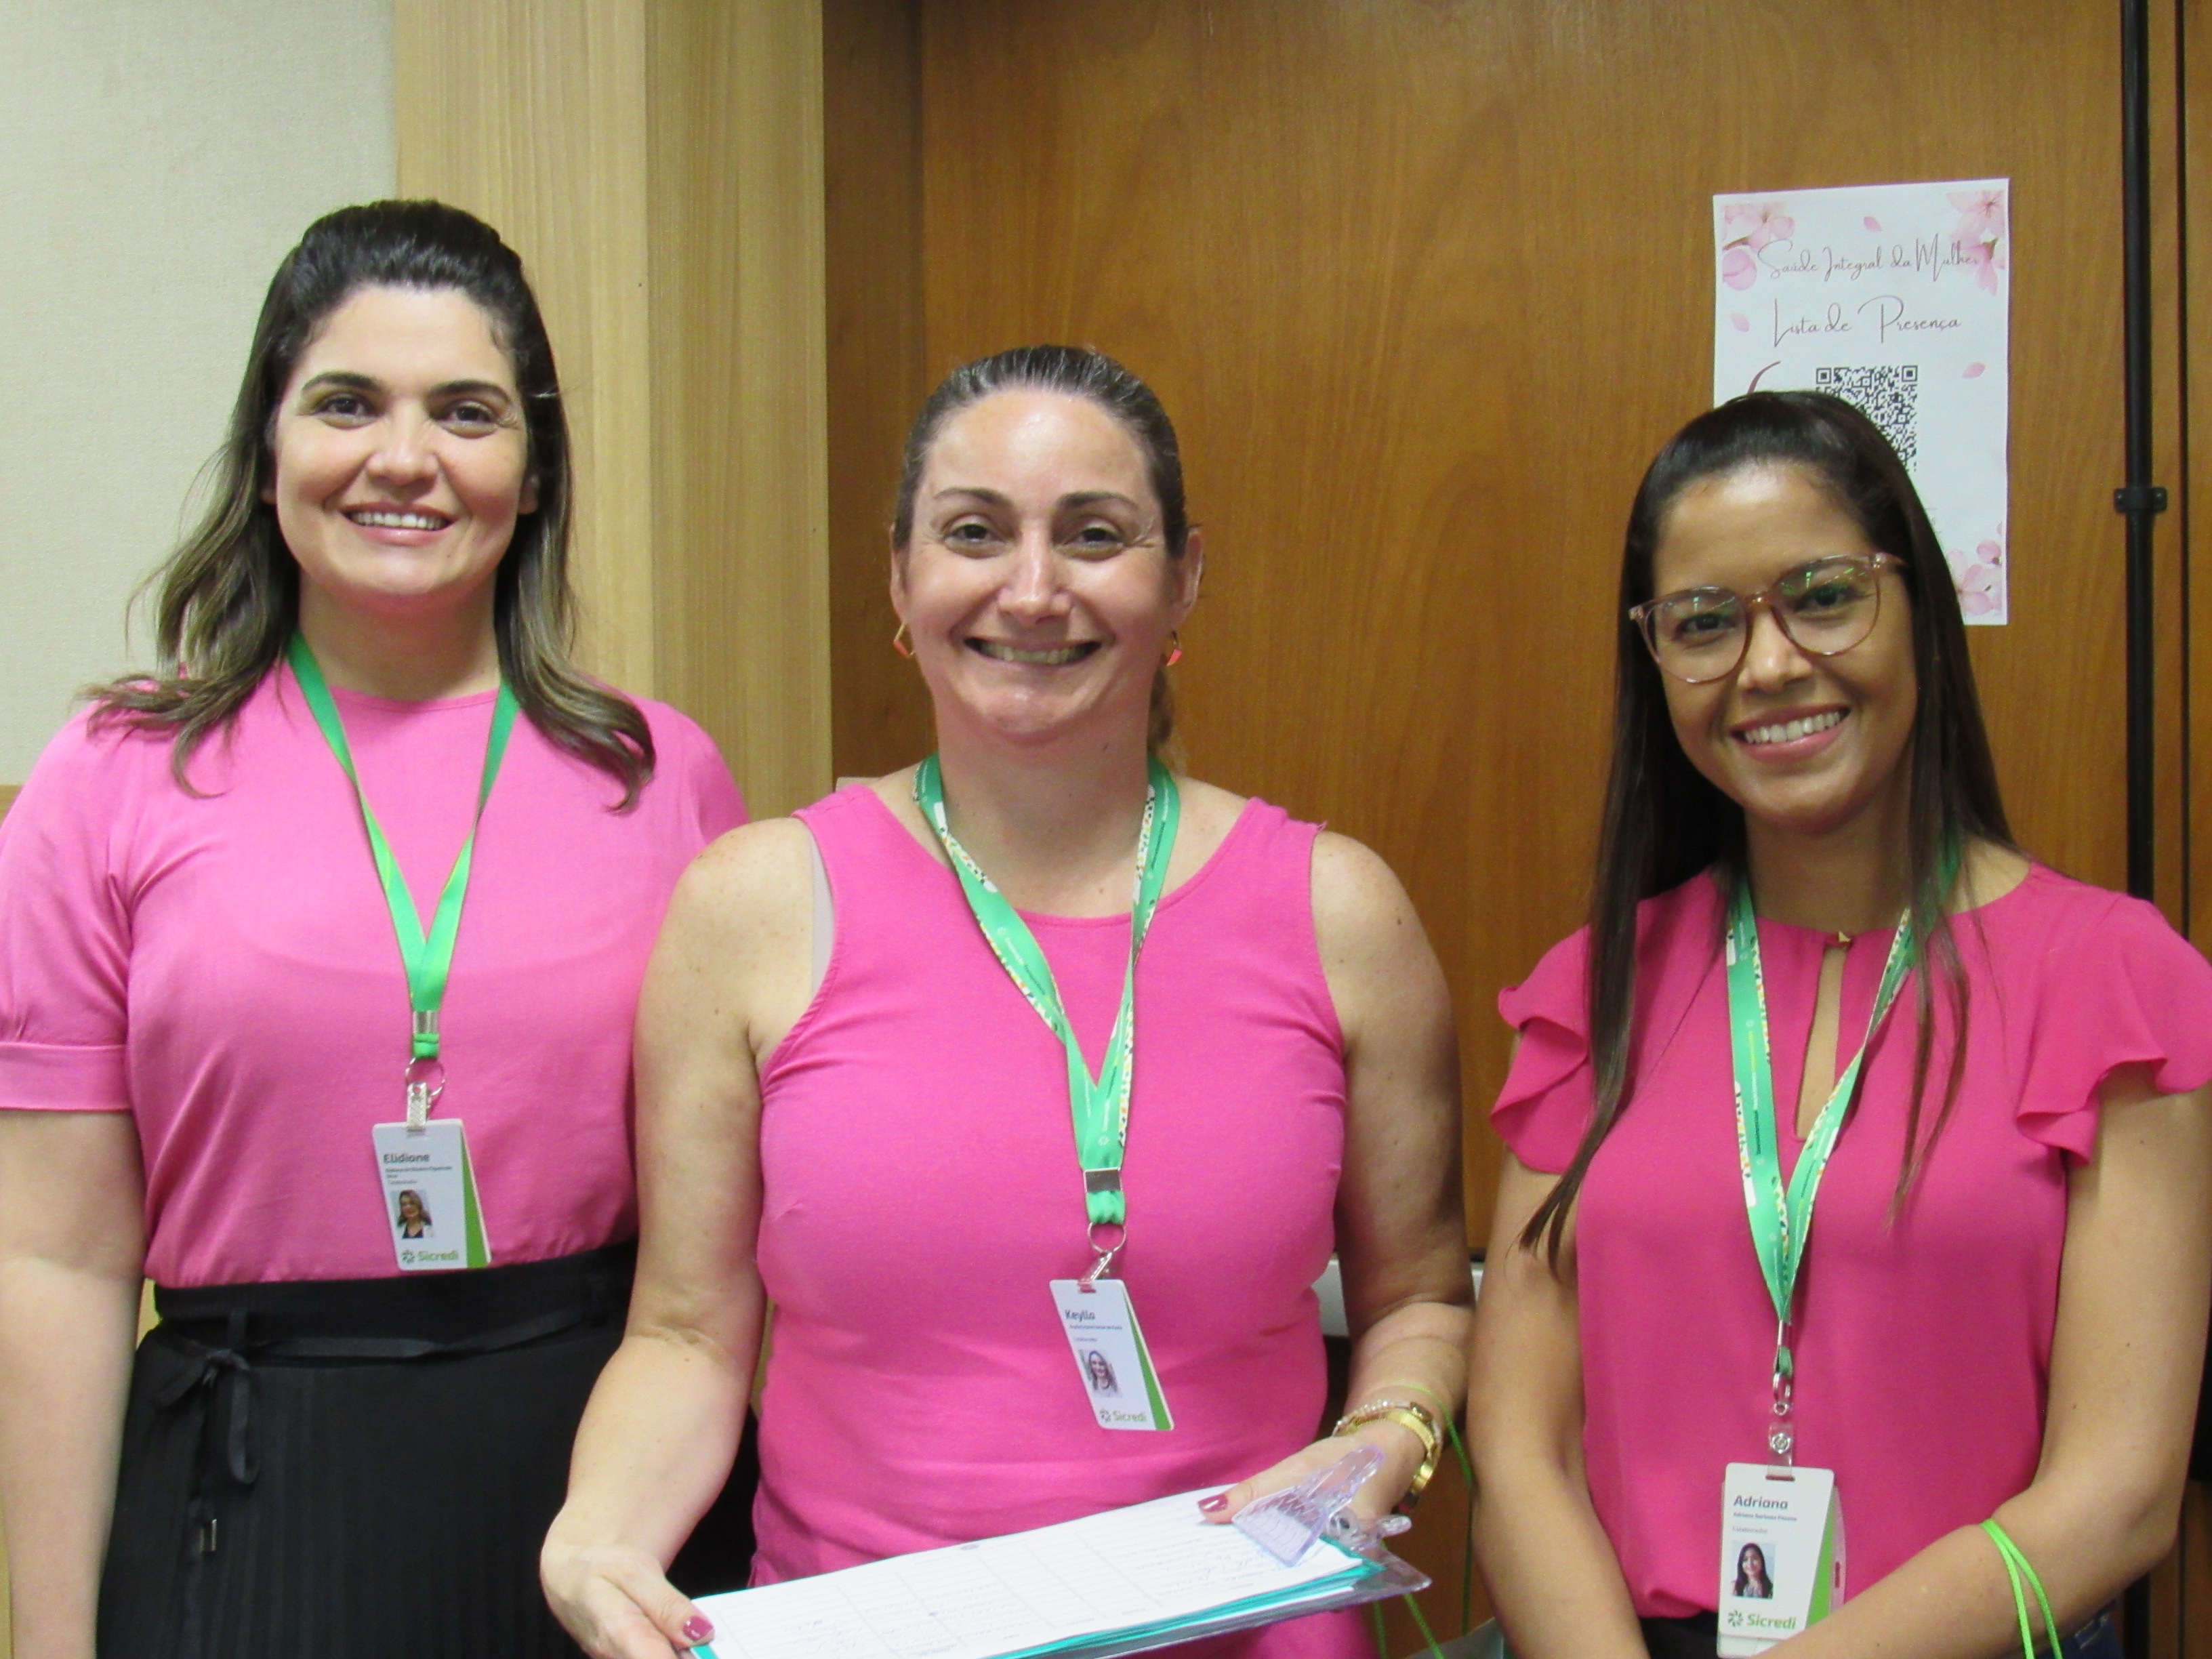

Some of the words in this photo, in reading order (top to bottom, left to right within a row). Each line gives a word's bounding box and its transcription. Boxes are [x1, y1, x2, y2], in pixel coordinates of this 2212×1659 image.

[1757, 237, 1819, 279] Saúde
[1822, 245, 1883, 282] Integral
[1890, 244, 1912, 268] da
[1915, 232, 1980, 282] Mulher
[1774, 298, 1821, 348] Lista
[1824, 302, 1853, 332] de
[1857, 295, 1961, 344] Presença
[1733, 1494, 1789, 1510] Adriana
[1746, 1613, 1797, 1630] Sicredi
